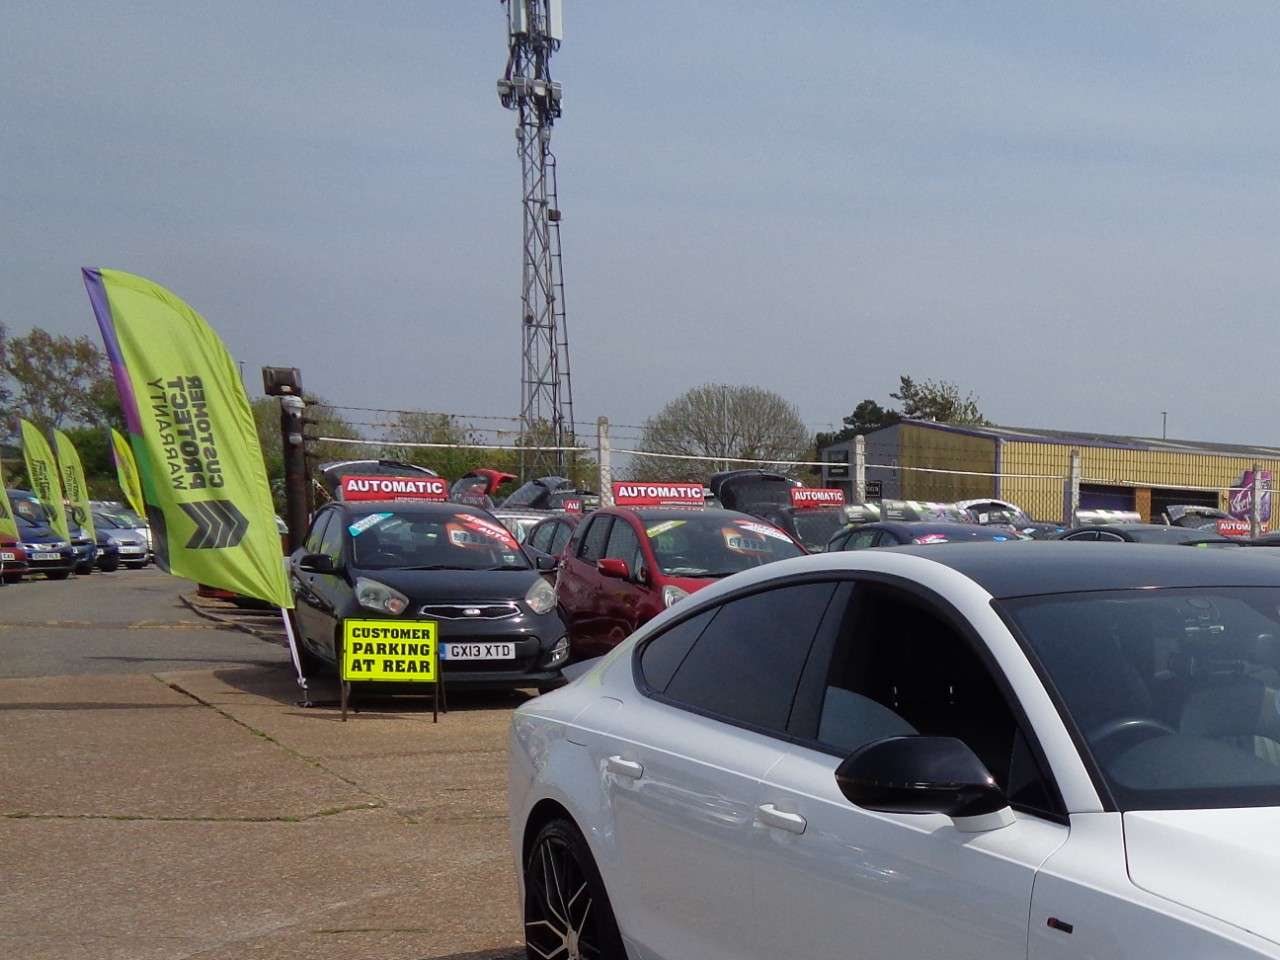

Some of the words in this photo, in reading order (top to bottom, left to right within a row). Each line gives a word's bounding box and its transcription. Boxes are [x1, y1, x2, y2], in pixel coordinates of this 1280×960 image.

[347, 480, 443, 493] AUTOMATIC
[618, 486, 701, 498] AUTOMATIC
[795, 491, 843, 500] AUTOMATIC
[1220, 523, 1266, 532] AUTOMC
[352, 628, 430, 640] CUSTOMER
[352, 642, 430, 656] PARKING
[451, 645, 481, 657] GX13
[485, 645, 511, 657] XTD
[351, 659, 376, 672] AT
[383, 660, 430, 673] REAR
